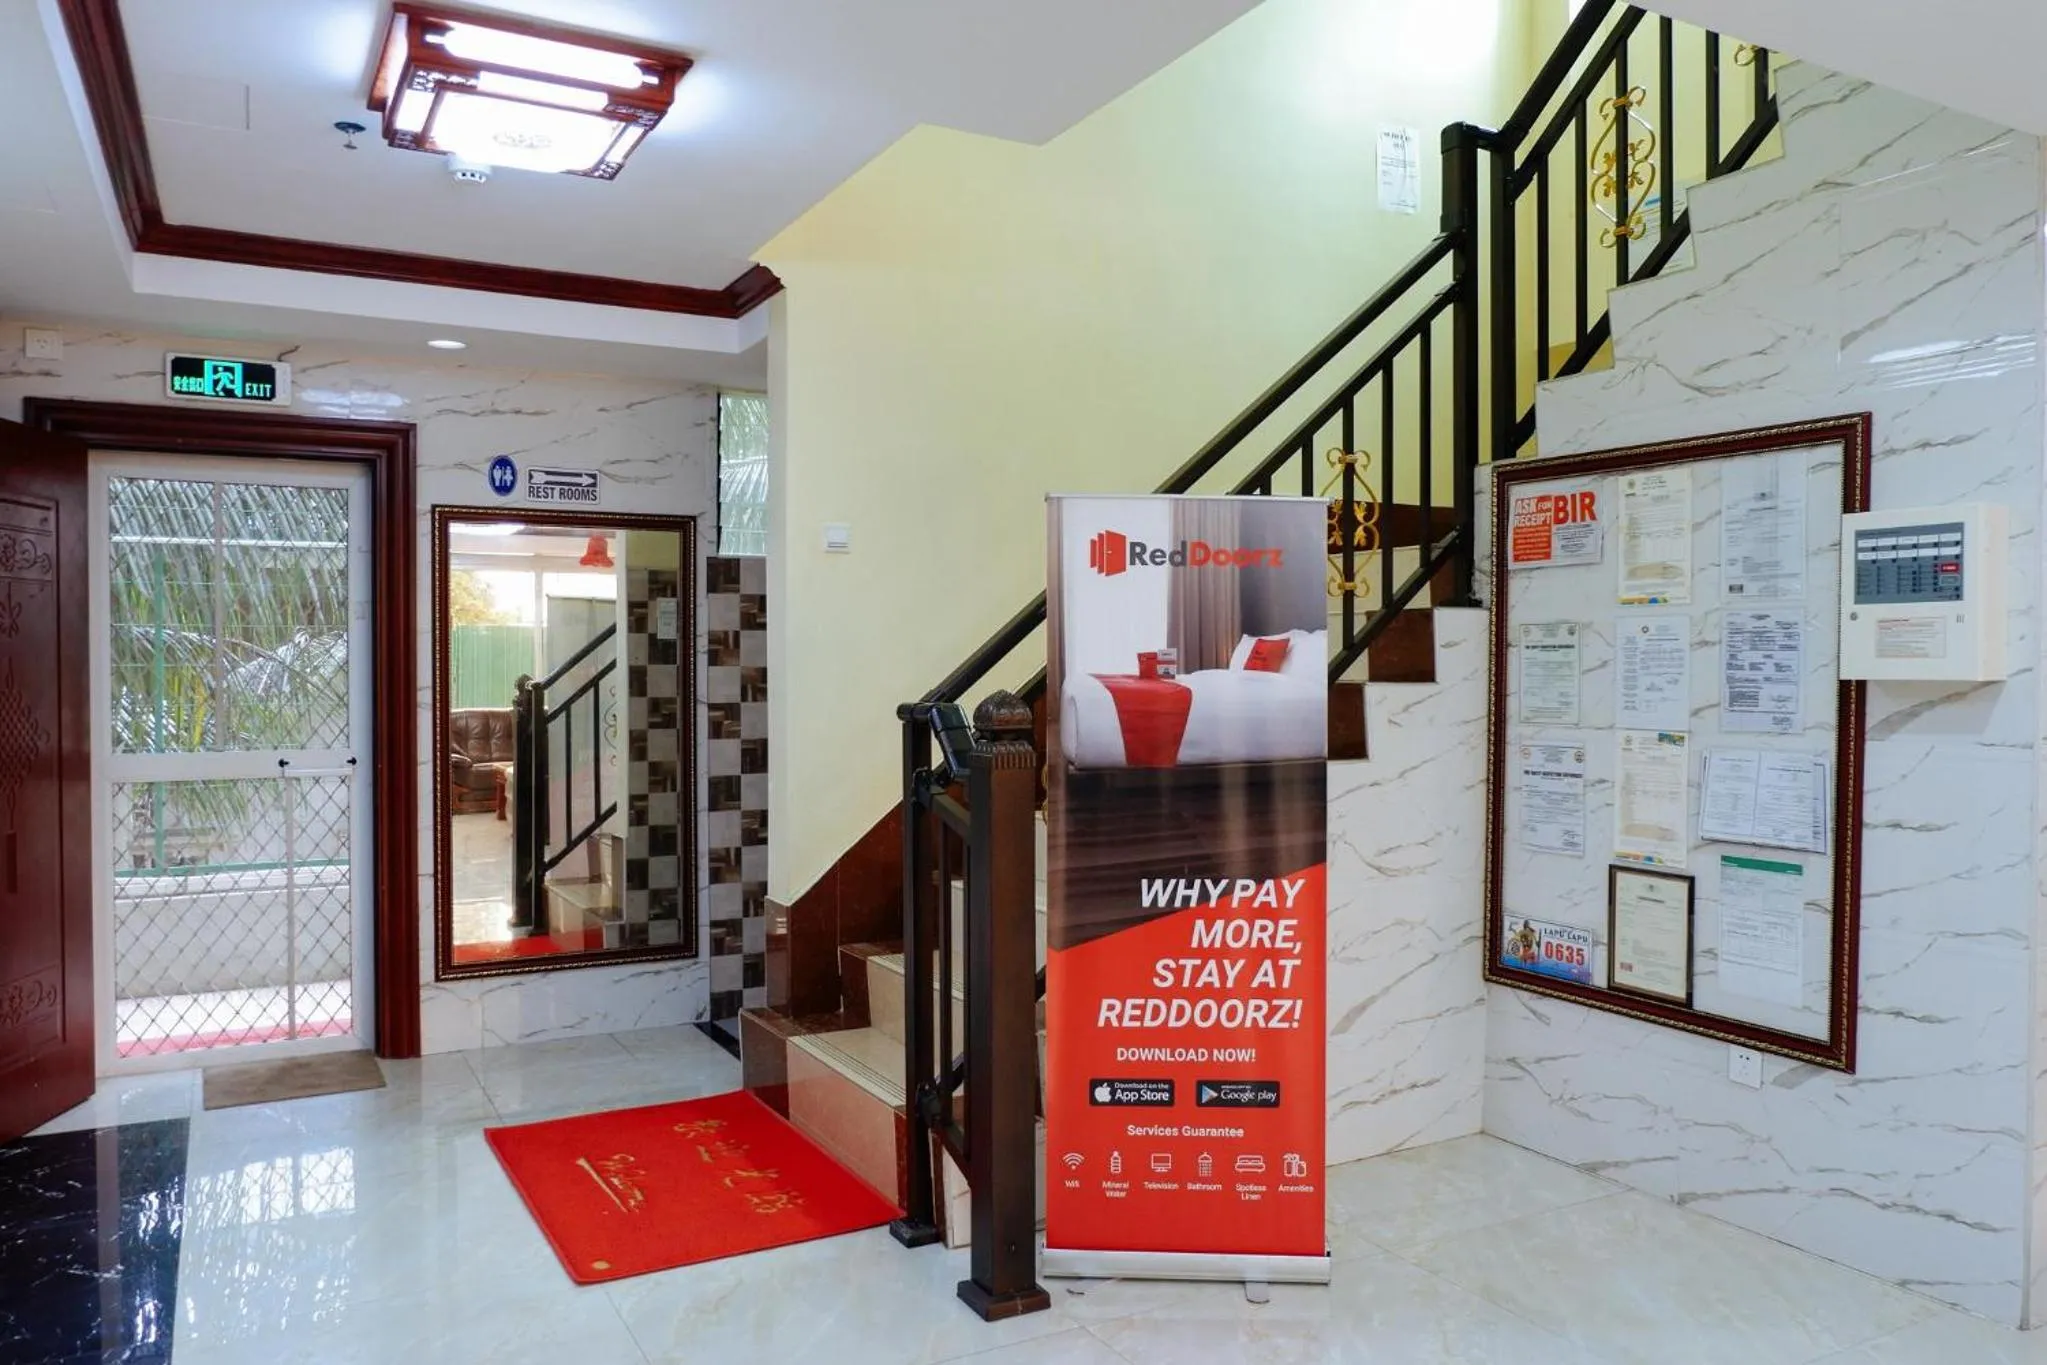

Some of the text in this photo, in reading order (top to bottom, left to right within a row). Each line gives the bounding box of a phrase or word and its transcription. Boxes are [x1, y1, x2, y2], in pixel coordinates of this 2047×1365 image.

[245, 382, 272, 397] EXIT
[528, 485, 597, 501] REST ROOMS
[1515, 499, 1537, 513] ASK
[1553, 491, 1597, 524] BIR
[1129, 540, 1284, 568] RedDoorz
[1141, 878, 1305, 908] WHY PAY
[1191, 919, 1302, 954] MORE,
[1544, 940, 1585, 966] 0635
[1152, 958, 1301, 988] STAY AT
[1097, 998, 1303, 1028] REDDOORZ!
[1117, 1048, 1256, 1062] DOWNLOAD NOW!
[1115, 1089, 1170, 1102] App Store
[1220, 1089, 1277, 1103] Google play
[1127, 1125, 1244, 1138] Services Guarantee
[1102, 1181, 1129, 1189] Mineral
[1143, 1181, 1179, 1190] Television
[1187, 1182, 1222, 1191] Bathroom
[1235, 1183, 1267, 1192] Spotless
[1278, 1184, 1314, 1193] Amenities
